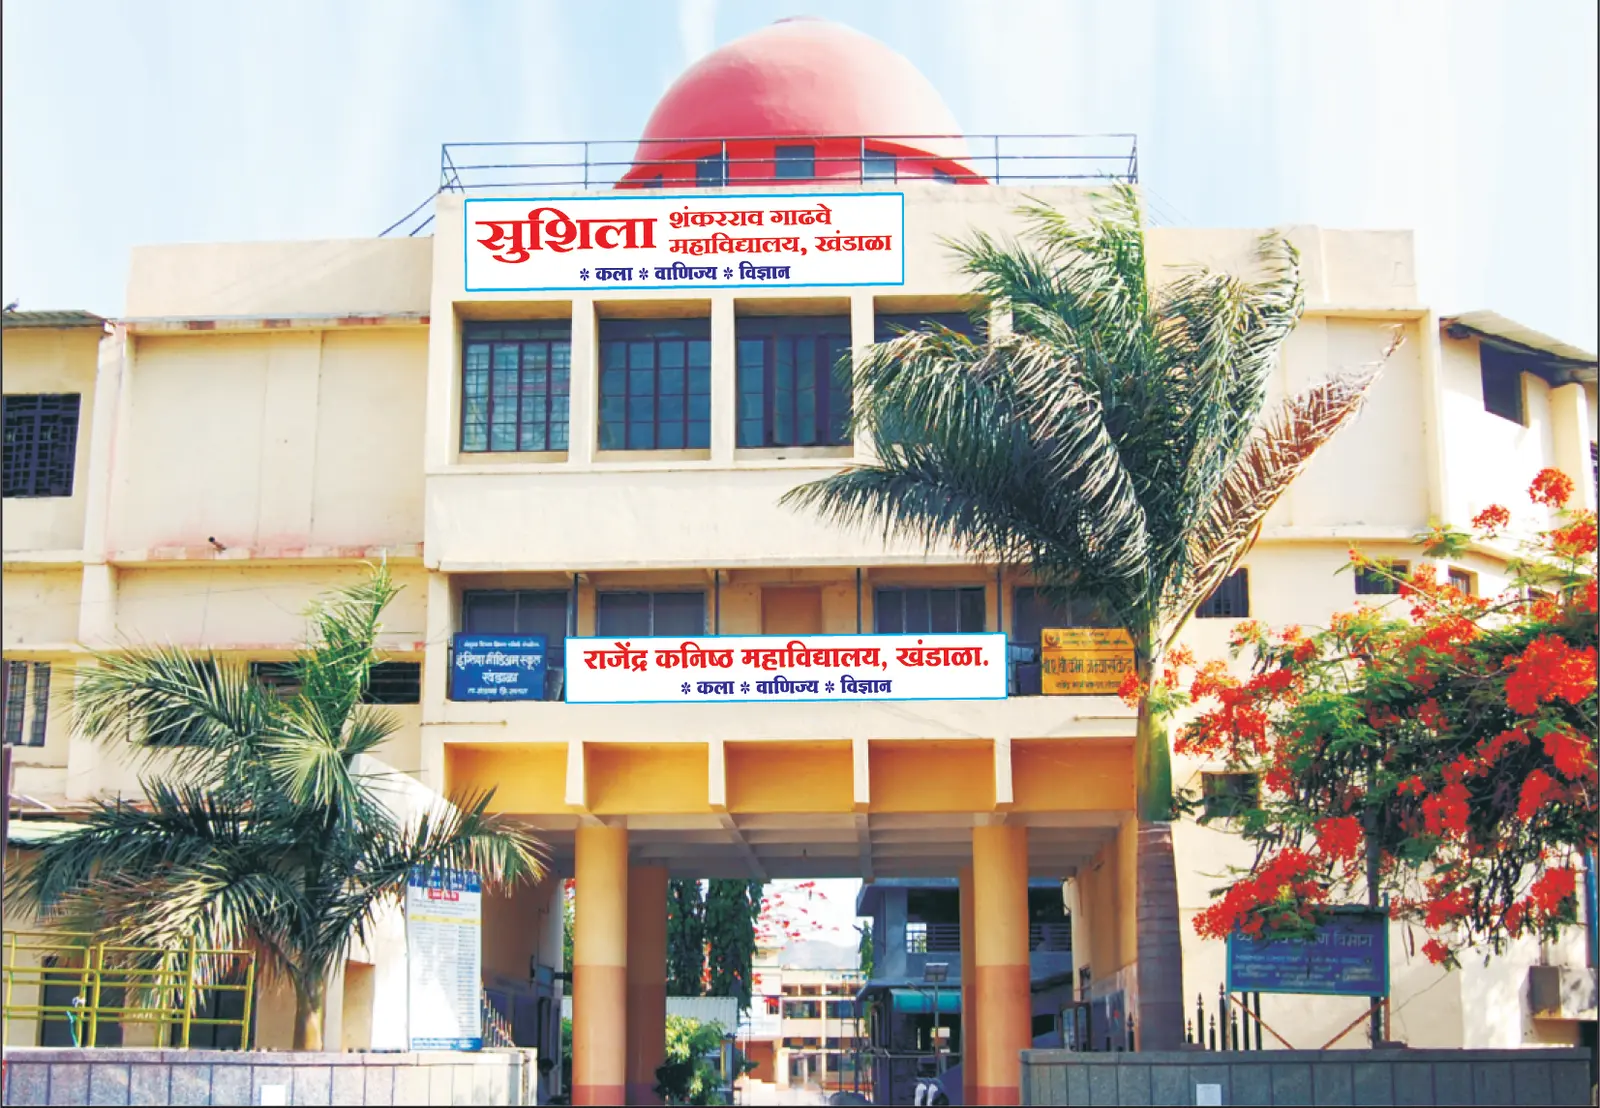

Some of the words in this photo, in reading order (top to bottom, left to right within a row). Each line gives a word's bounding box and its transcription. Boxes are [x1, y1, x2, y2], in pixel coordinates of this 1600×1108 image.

[669, 205, 764, 229] शंकरराव
[770, 203, 832, 226] गाढवे
[475, 207, 658, 264] सुशिला
[669, 232, 808, 256] महाविद्यालय,
[814, 229, 892, 252] खंडाळा
[595, 267, 634, 281] कला
[654, 262, 718, 281] वाणिज्य
[739, 261, 791, 280] विज्ञान
[584, 641, 648, 673] राजेंद्र
[655, 641, 735, 669] कनिष्ठ
[741, 640, 888, 671] महाविद्यालय,
[896, 638, 989, 668] खंडाळा.
[697, 680, 735, 695] कला
[756, 675, 820, 695] वाणिज्य
[840, 674, 893, 695] विज्ञान
